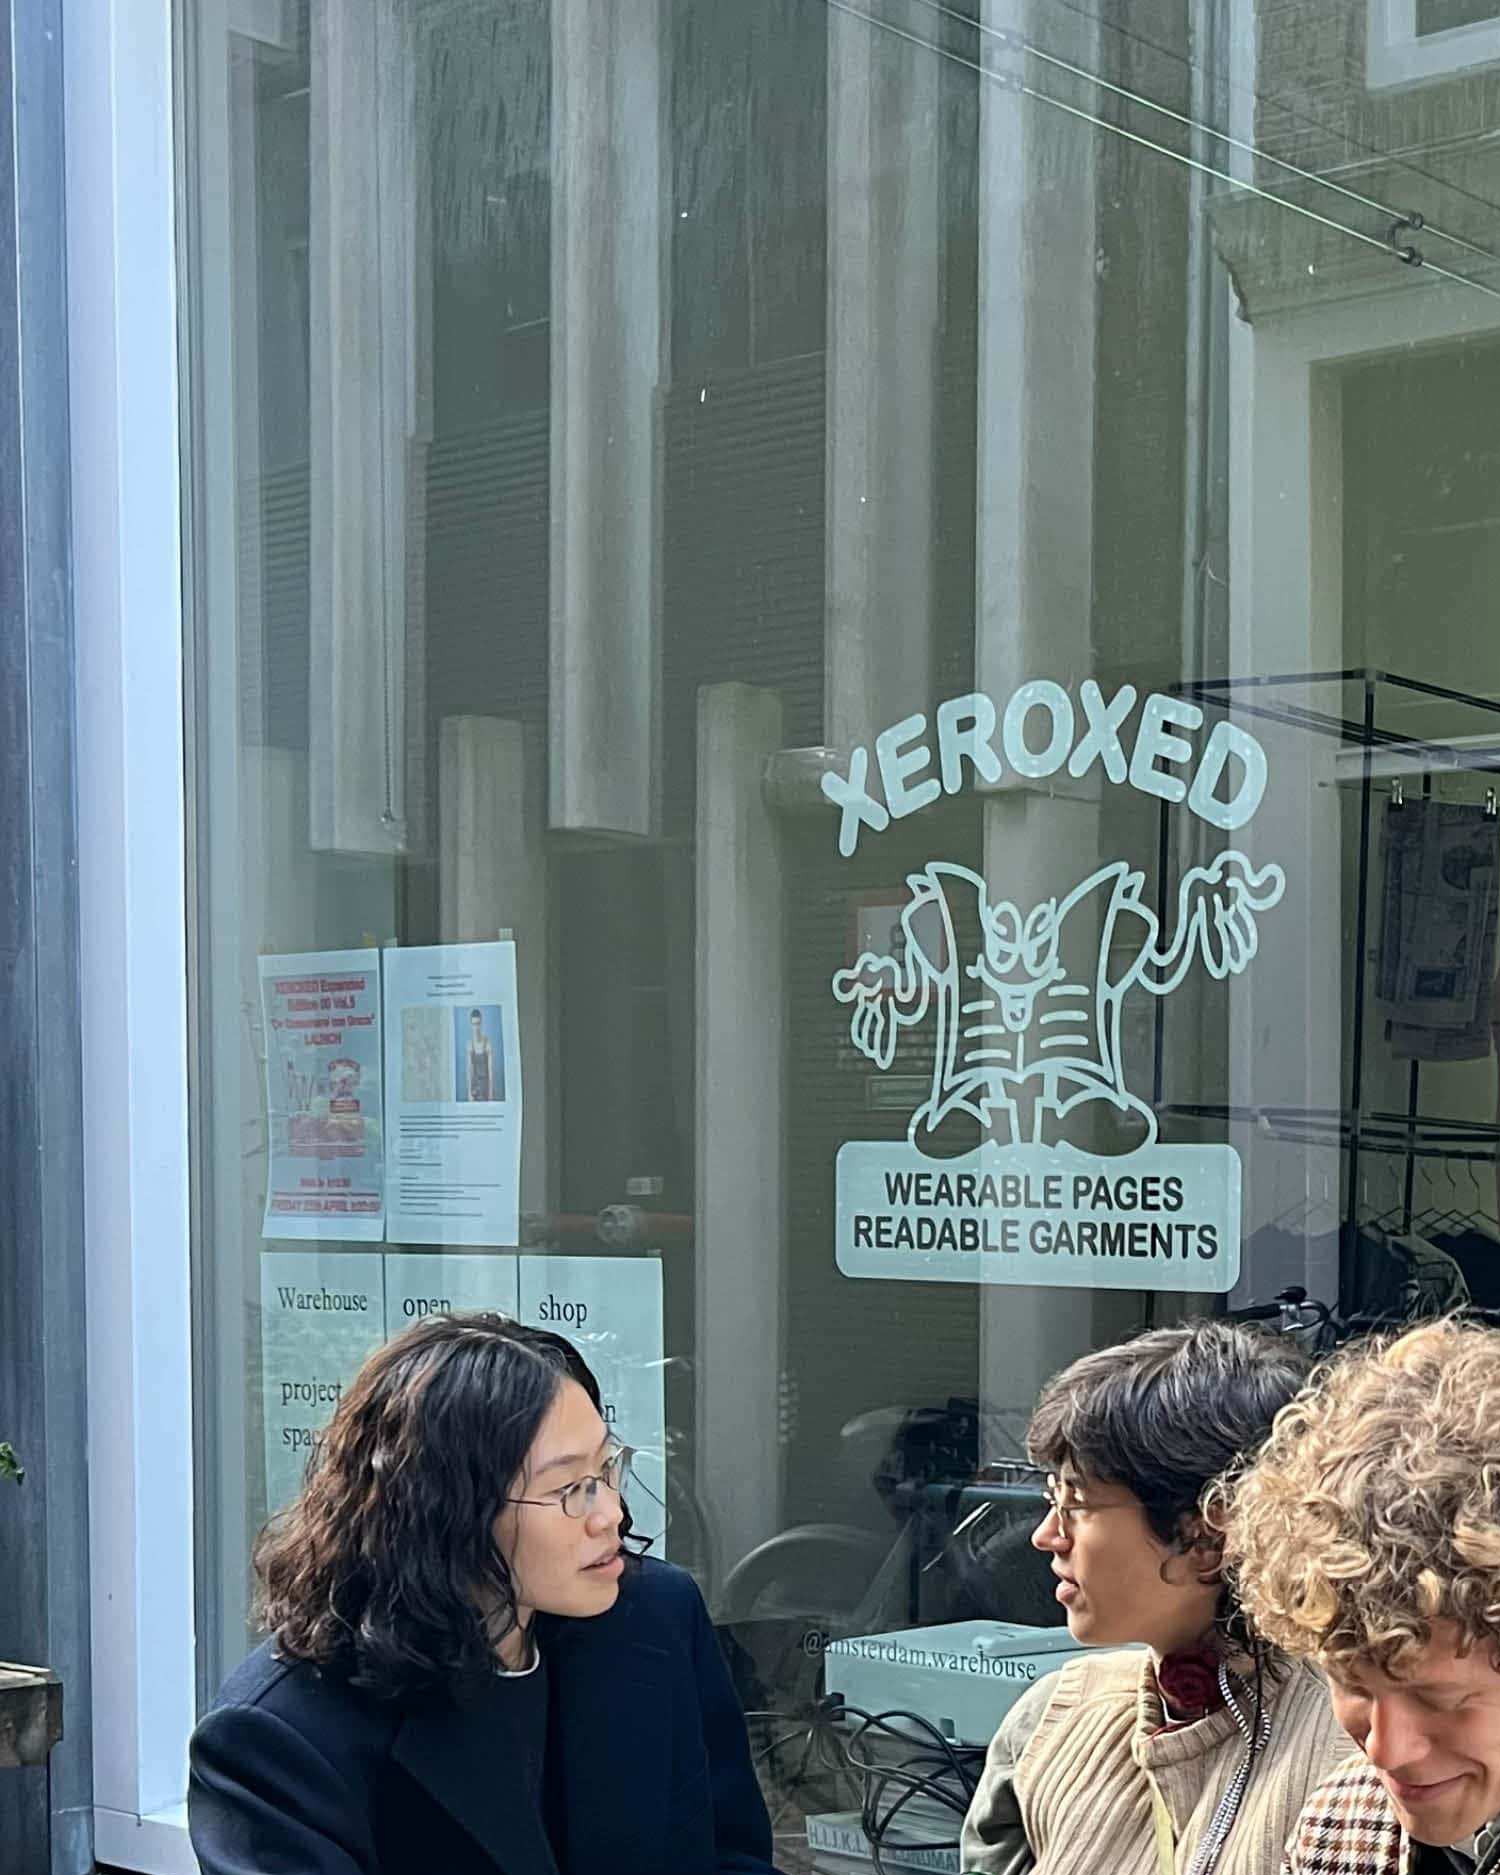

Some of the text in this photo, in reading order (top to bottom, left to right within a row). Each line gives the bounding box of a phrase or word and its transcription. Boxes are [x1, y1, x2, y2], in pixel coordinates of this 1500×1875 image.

[820, 679, 1268, 857] XEROXED
[884, 1172, 1184, 1213] WEARABLE PAGES
[852, 1216, 1219, 1261] READABLE GARMENTS
[278, 1286, 369, 1314] Warehouse
[538, 1294, 589, 1324] shop
[802, 1631, 1038, 1681] @amsterdam.warehouse
